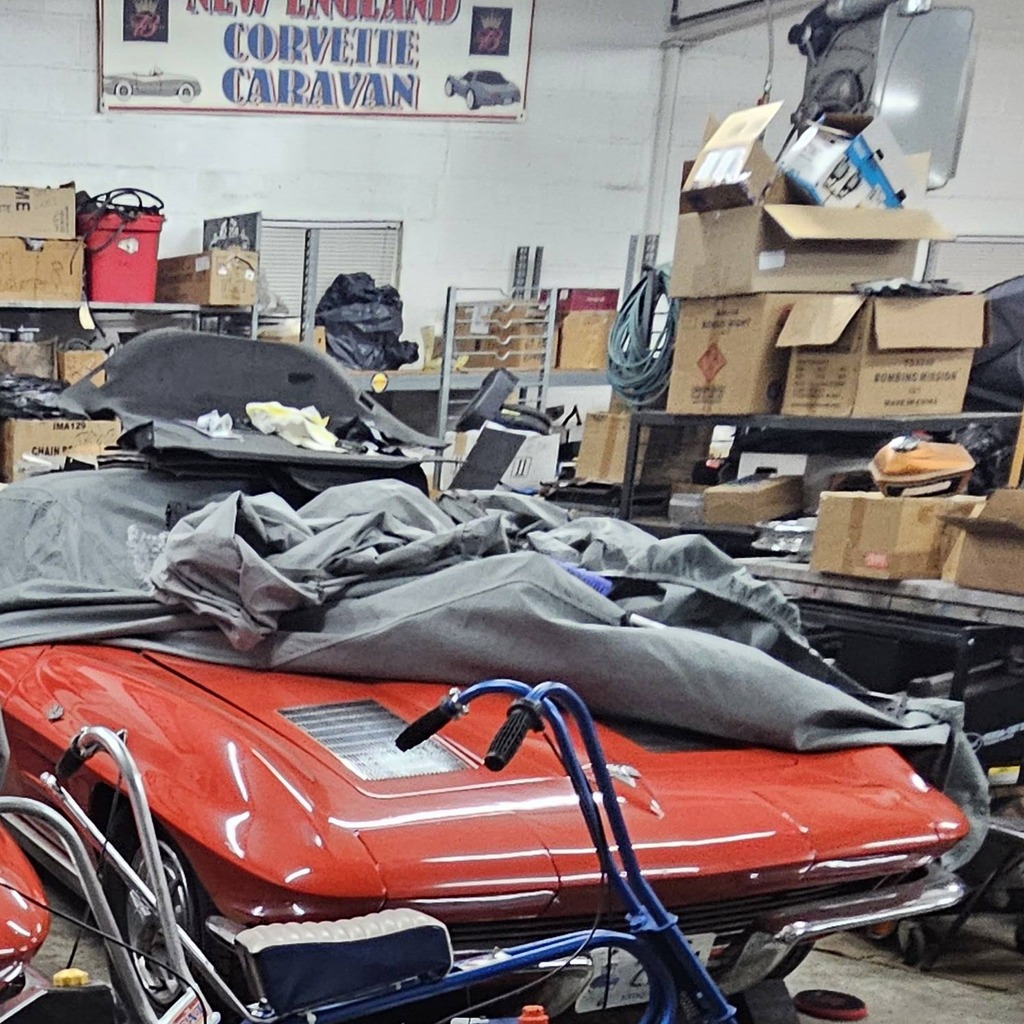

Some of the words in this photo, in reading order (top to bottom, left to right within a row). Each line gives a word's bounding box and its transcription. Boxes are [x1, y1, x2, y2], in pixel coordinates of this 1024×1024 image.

[223, 22, 420, 68] CORVETTE
[221, 67, 420, 110] CARAVAN
[31, 446, 60, 456] CHAIN
